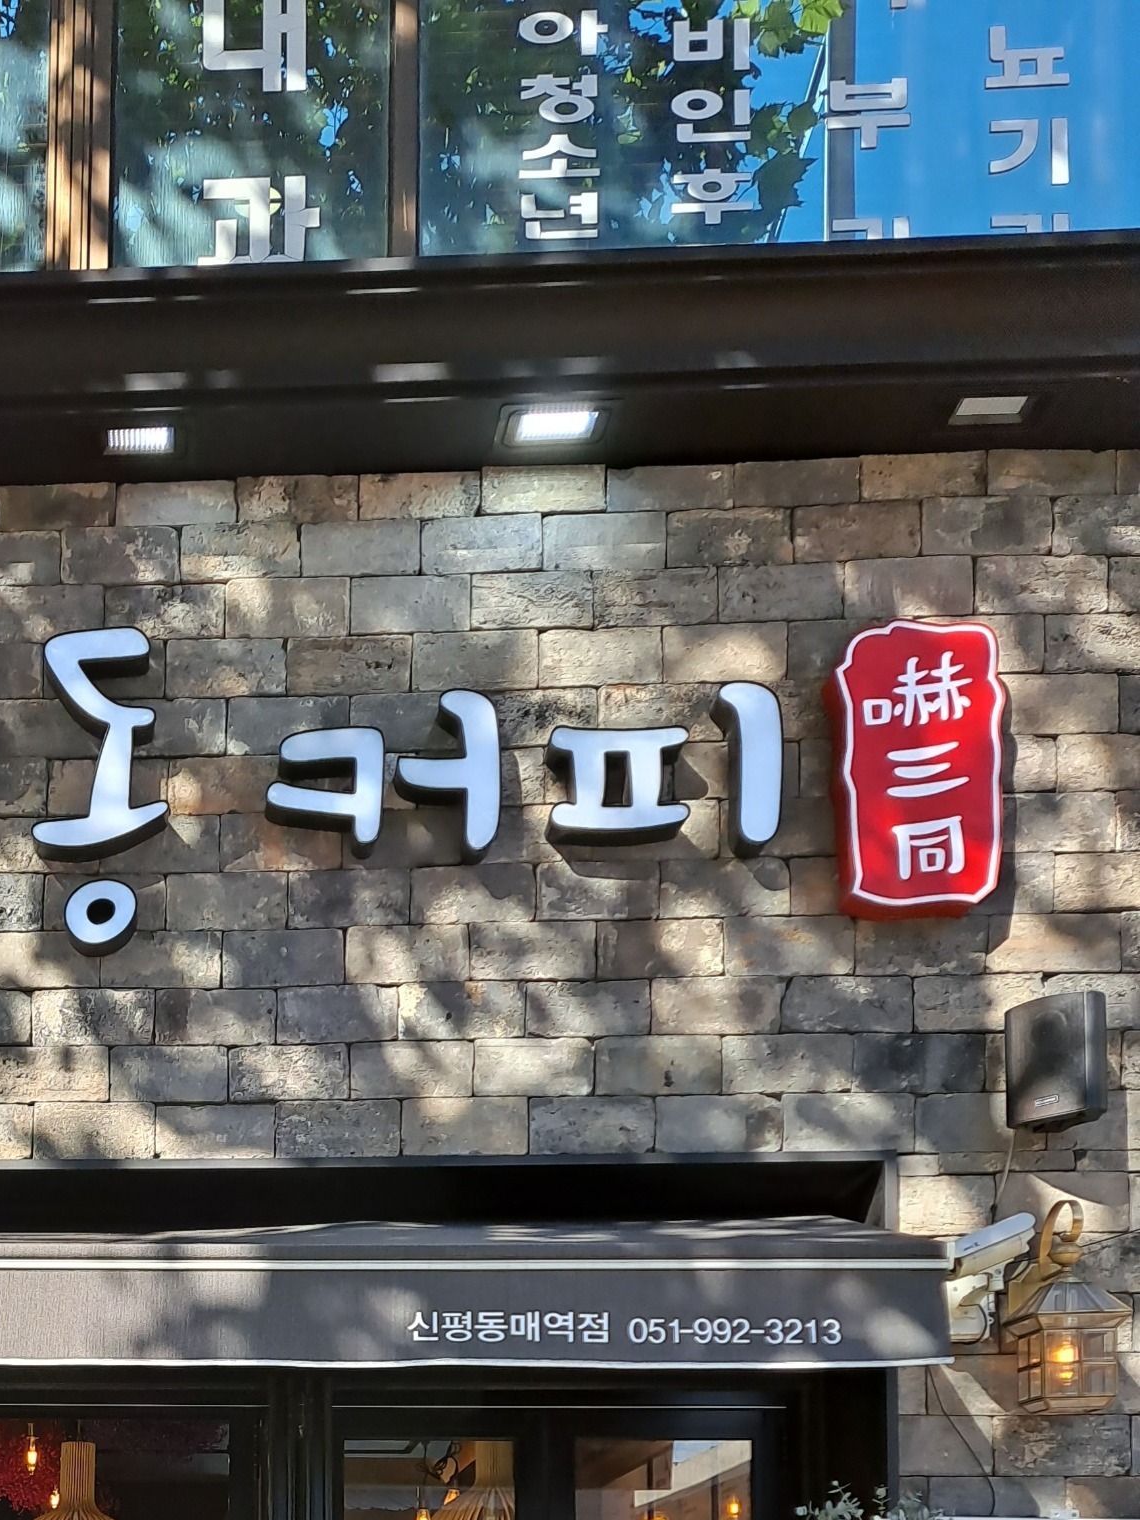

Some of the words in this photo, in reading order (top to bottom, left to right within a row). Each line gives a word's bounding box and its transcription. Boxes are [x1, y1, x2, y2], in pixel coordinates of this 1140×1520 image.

[265, 681, 785, 862] 커피
[407, 1310, 610, 1344] 신평동매역점
[628, 1317, 843, 1345] 051-992-3213
